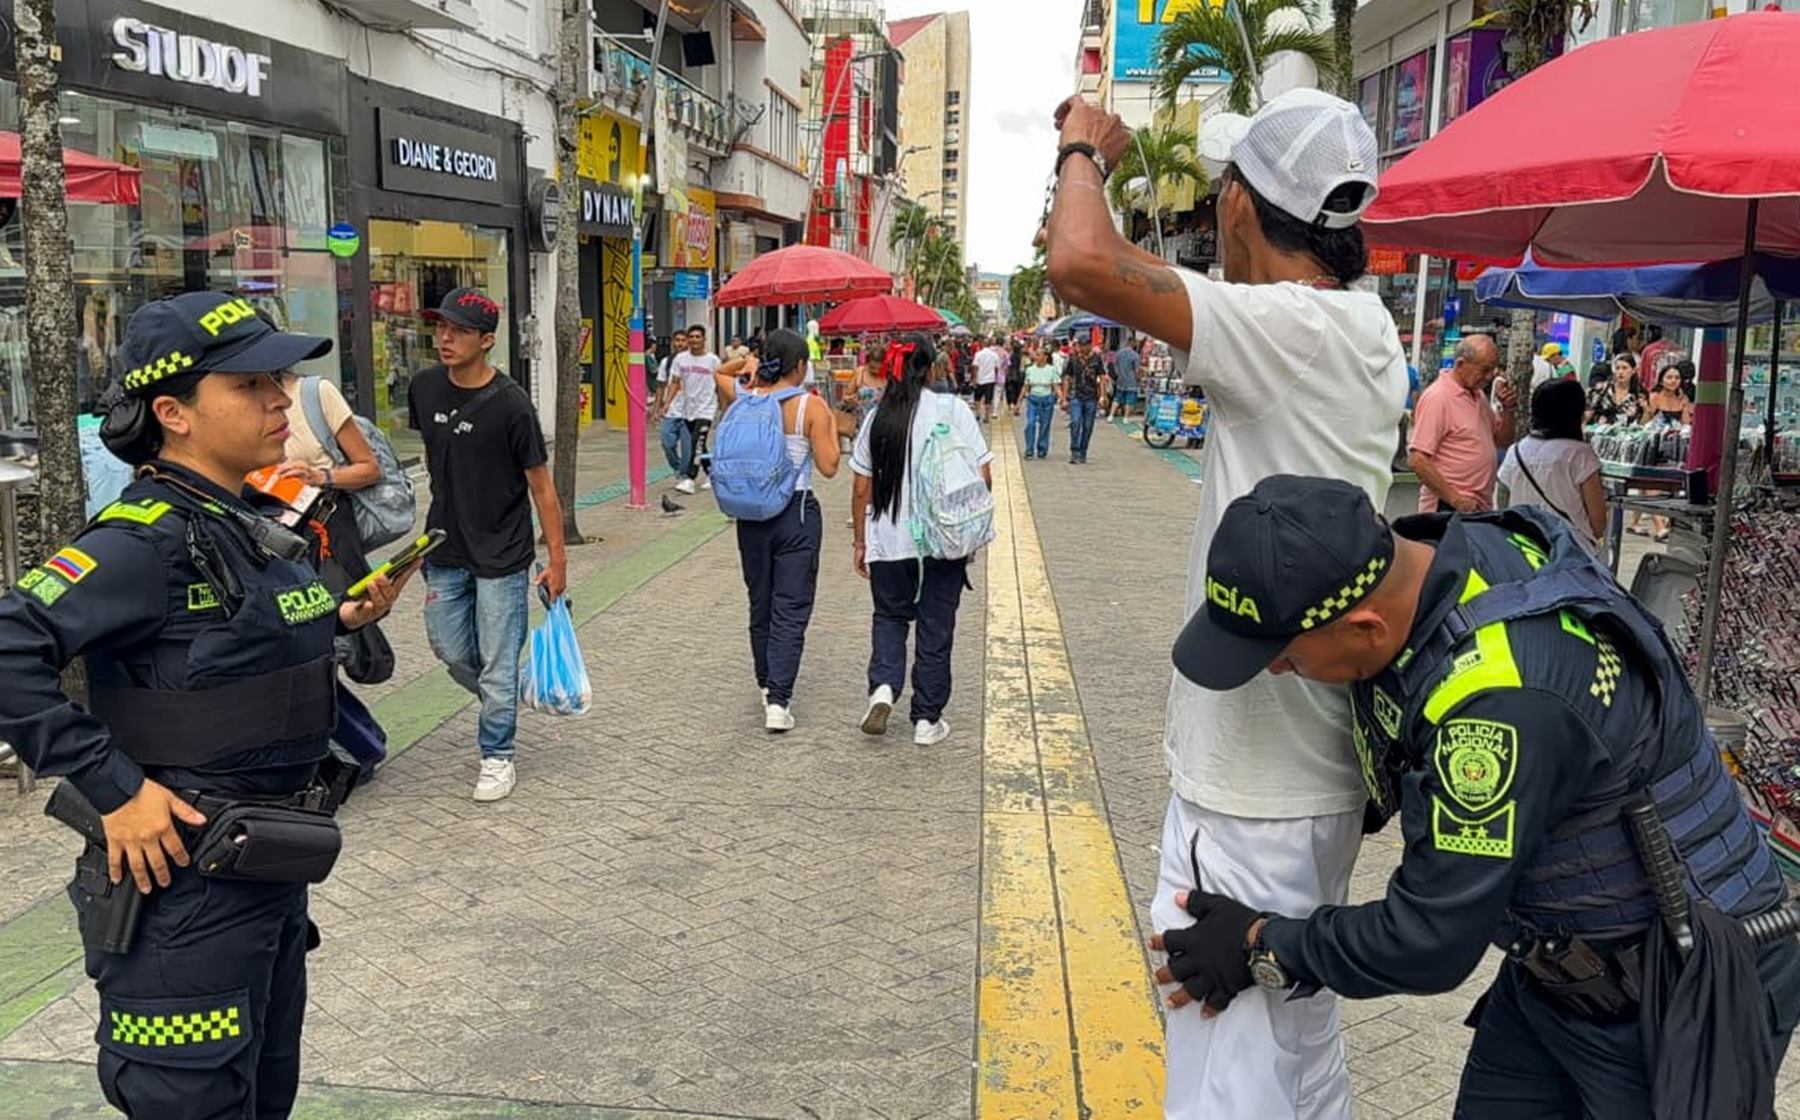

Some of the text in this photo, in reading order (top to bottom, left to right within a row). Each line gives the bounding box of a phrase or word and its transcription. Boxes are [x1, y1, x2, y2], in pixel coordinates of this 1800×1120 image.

[398, 138, 497, 182] DIANE & GEORDI
[1441, 737, 1509, 761] NACIONAL
